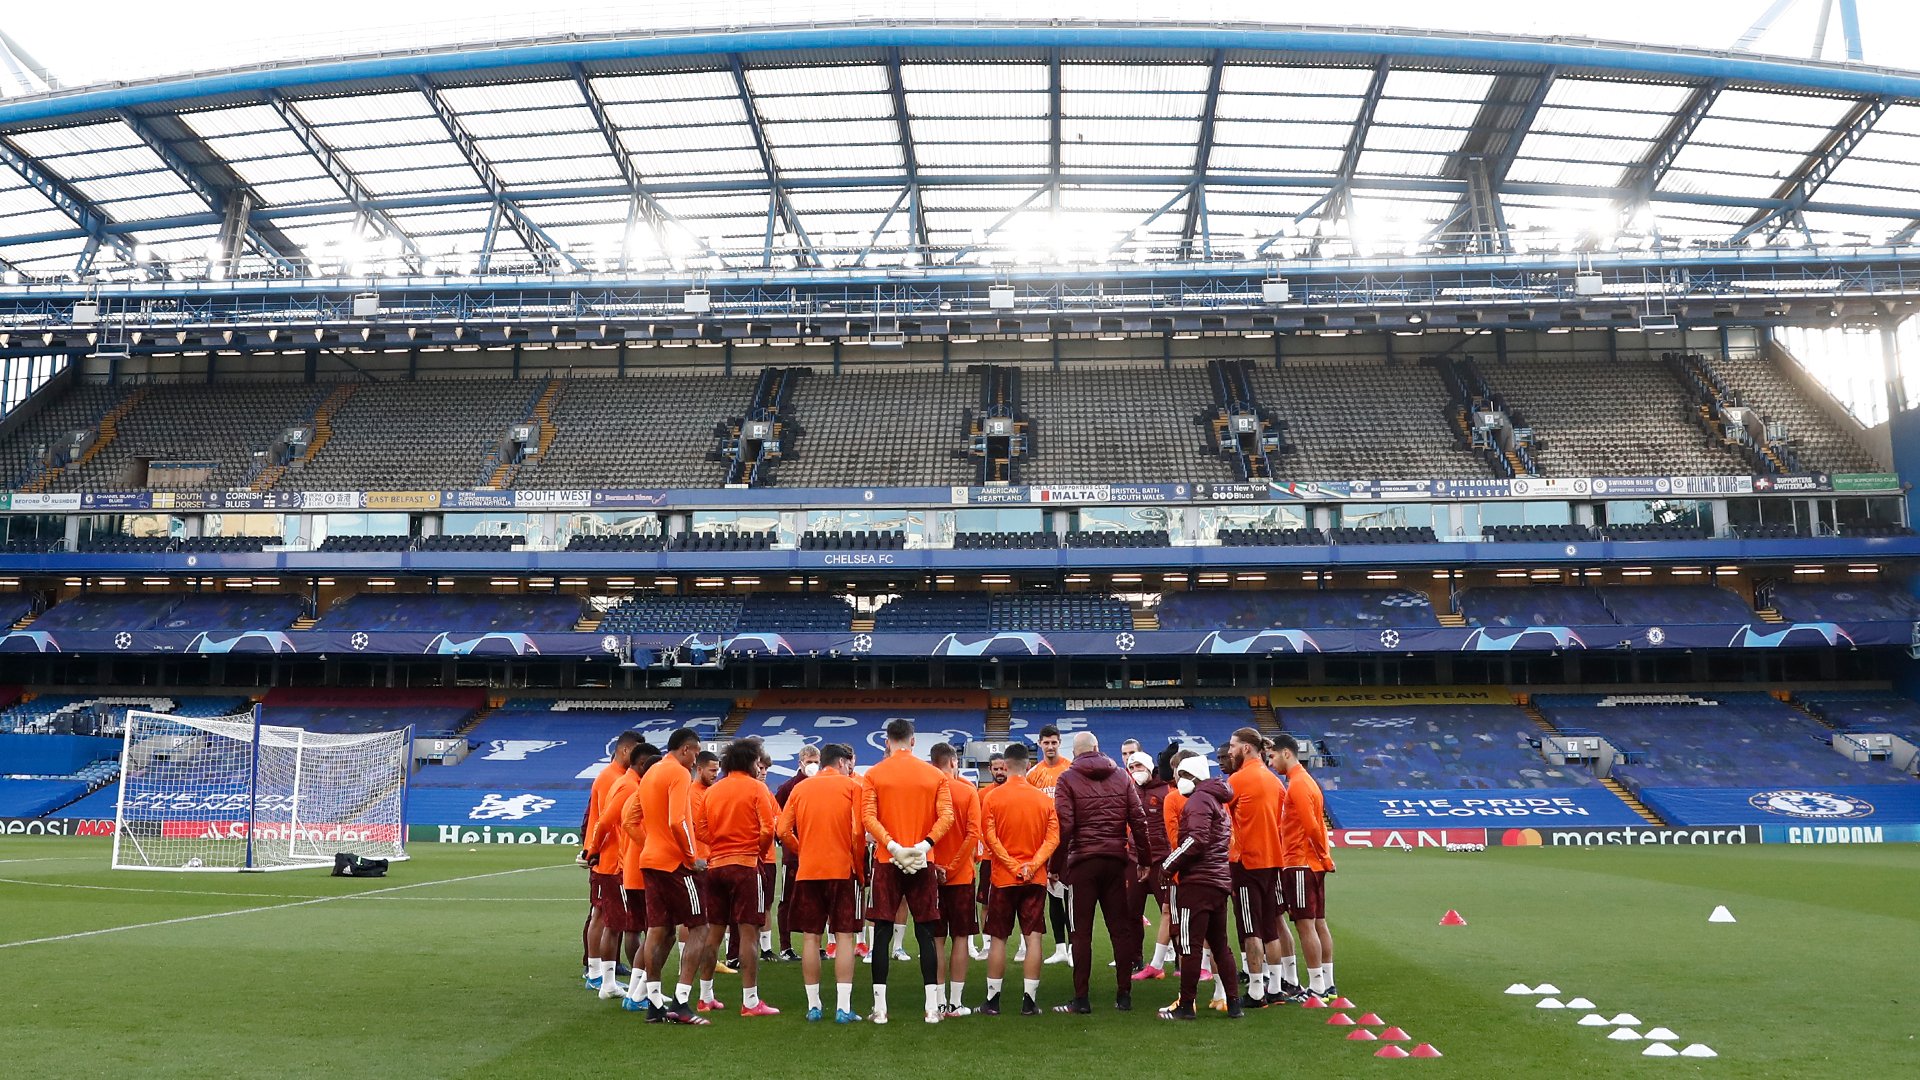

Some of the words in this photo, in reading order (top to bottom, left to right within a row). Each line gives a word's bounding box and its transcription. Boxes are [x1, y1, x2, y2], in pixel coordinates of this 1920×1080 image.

[1687, 477, 1715, 492] HELLENIC
[1718, 477, 1738, 492] BLUES
[517, 491, 556, 501] SOUTH
[558, 491, 590, 500] WEST
[1052, 492, 1094, 500] MALTA
[824, 554, 876, 564] CHELSEA
[878, 554, 894, 564] FC
[1862, 740, 1867, 748] 8
[202, 794, 307, 803] PRIDE
[1380, 799, 1458, 808] THE
[1462, 798, 1576, 807] PRIDE
[150, 802, 297, 812] LONDON
[1382, 808, 1420, 817] OF
[1426, 807, 1590, 817] LONDON
[438, 825, 580, 844] Heineke
[1553, 826, 1745, 845] mastercard
